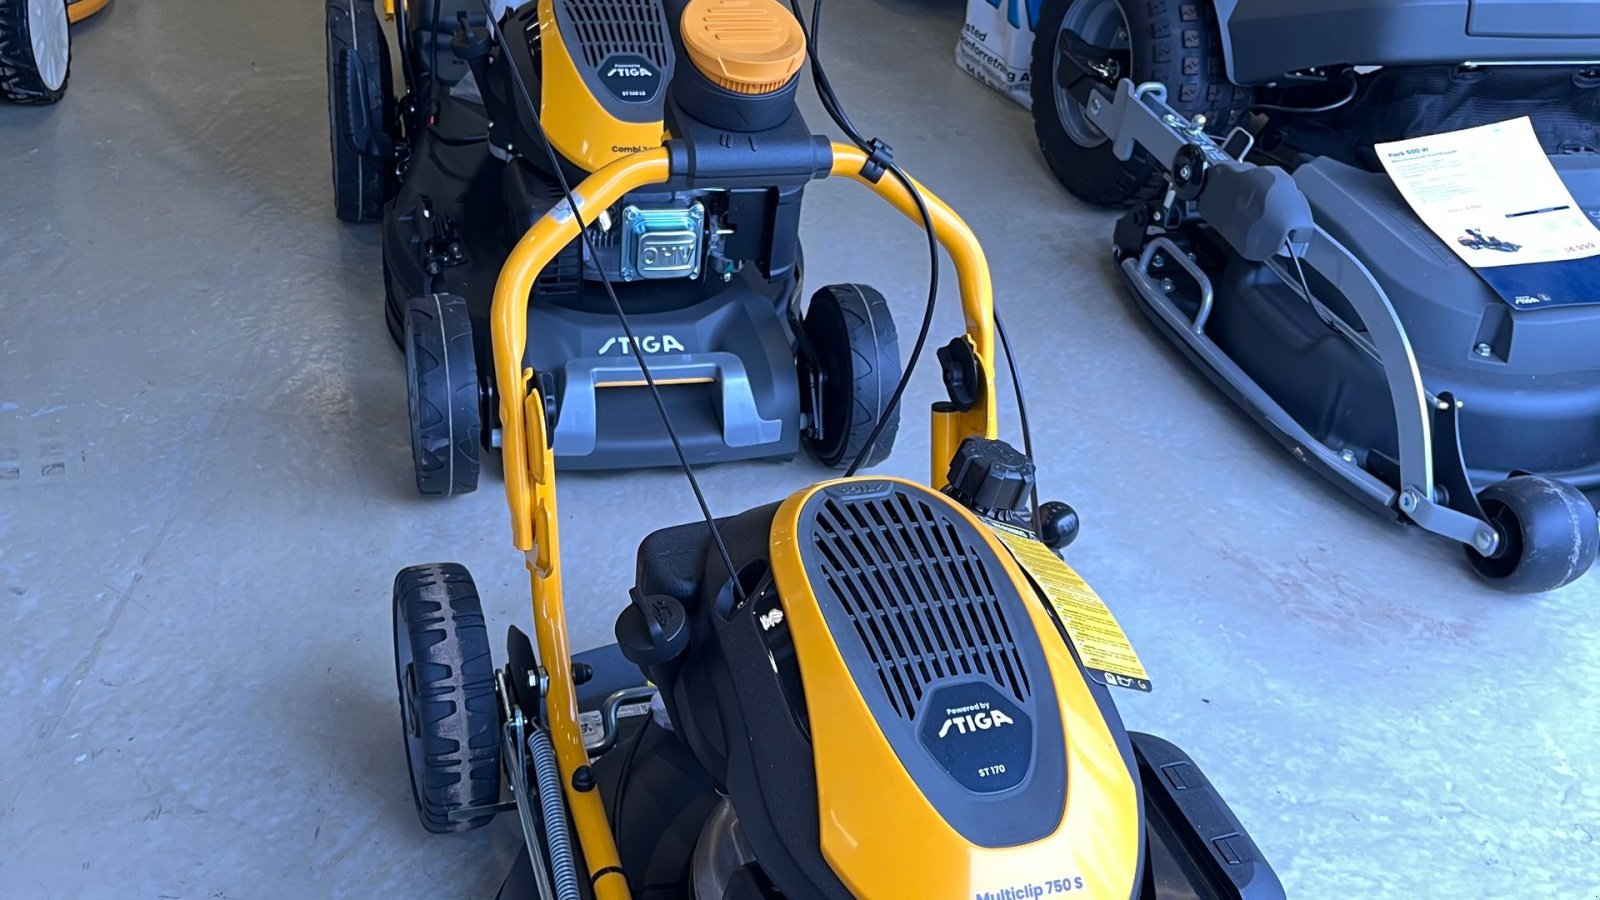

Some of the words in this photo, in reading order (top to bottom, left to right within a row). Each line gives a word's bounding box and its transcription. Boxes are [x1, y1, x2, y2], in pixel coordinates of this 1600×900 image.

[607, 68, 652, 76] STIGA
[642, 245, 695, 265] OHV
[598, 335, 684, 355] STIGA
[946, 703, 980, 716] Powered
[979, 702, 990, 710] by
[938, 709, 1014, 738] STIGA
[978, 767, 990, 777] ST
[990, 764, 1006, 775] 170
[976, 883, 1043, 900] Multiclip
[1045, 878, 1072, 895] 750
[1074, 876, 1084, 889] S
